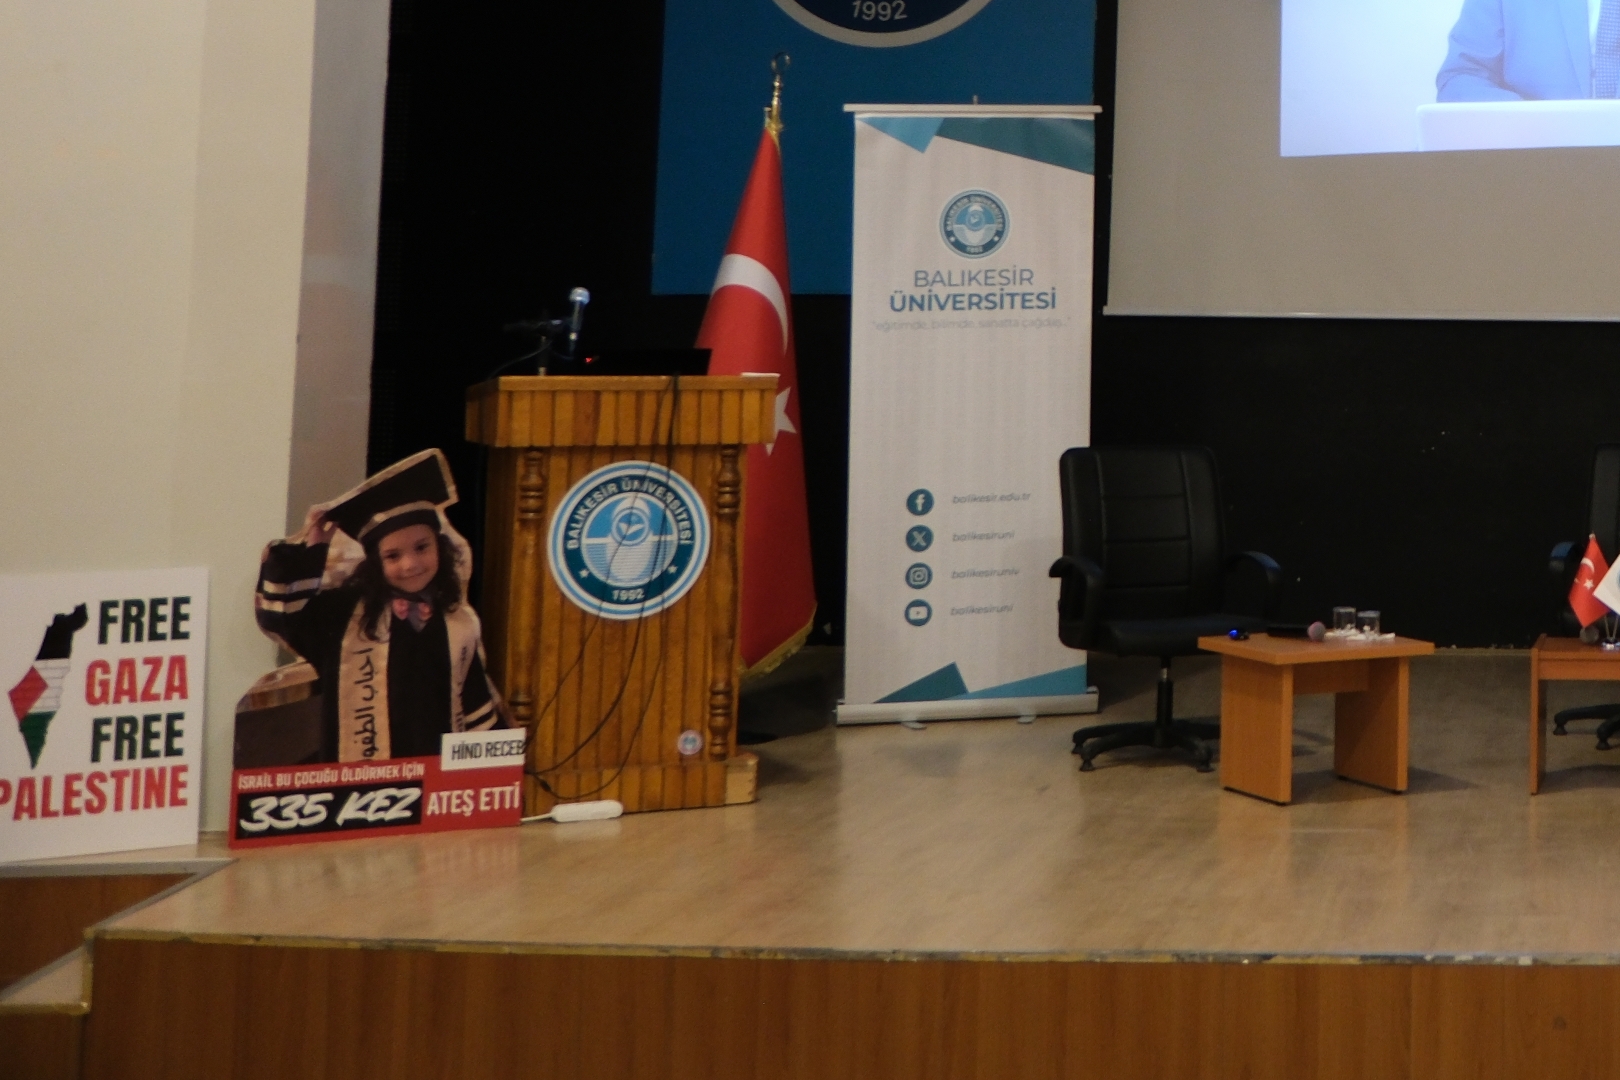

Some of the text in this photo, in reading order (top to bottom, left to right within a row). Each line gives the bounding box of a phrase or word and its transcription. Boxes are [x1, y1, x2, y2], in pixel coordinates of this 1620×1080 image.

[914, 265, 1034, 288] BALIKESİR
[889, 287, 1057, 312] ÜNİVERSİTESİ
[566, 477, 694, 550] BALIKESİR ÜNİVERSİTESİ
[612, 589, 645, 601] 1992
[98, 596, 191, 645] FREE
[85, 655, 188, 706] GAZA
[91, 712, 185, 763] FREE
[451, 738, 525, 760] HİND RECEB
[0, 764, 188, 821] PALESTINE
[238, 763, 425, 790] İSRAİL BU ÇOCUĞU ÖLDÜRMEK İÇİN
[239, 788, 422, 832] 335 KEZ
[427, 782, 520, 817] ATEŞ ETTİ
